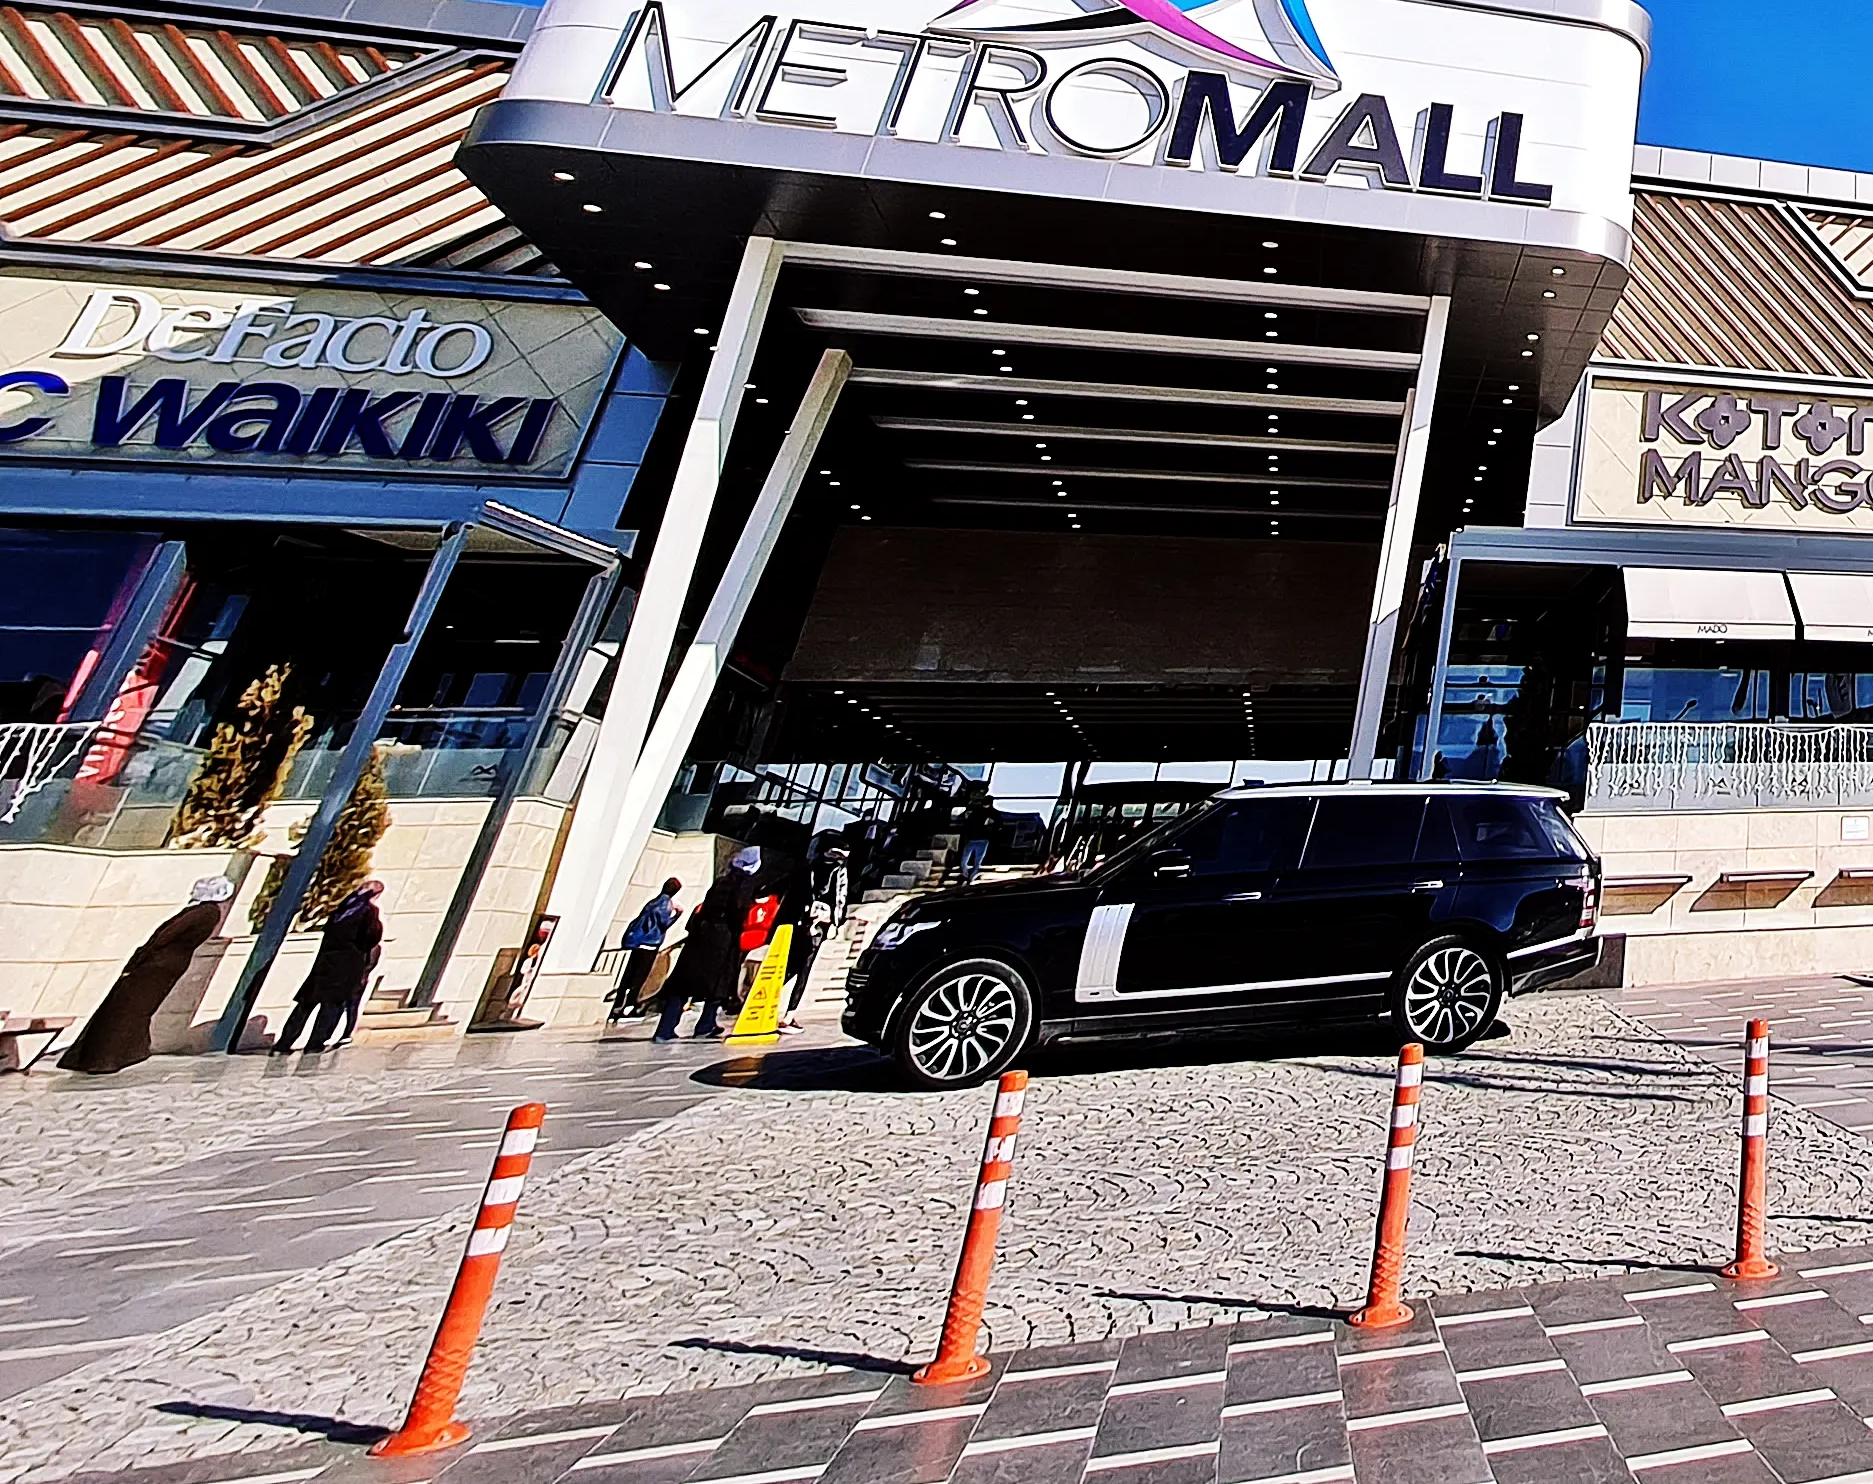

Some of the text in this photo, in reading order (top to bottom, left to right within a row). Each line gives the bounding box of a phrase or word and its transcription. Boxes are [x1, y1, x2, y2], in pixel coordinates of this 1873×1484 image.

[602, 0, 1554, 206] METROMALL
[50, 288, 493, 379] DeFacto
[1696, 624, 1729, 635] MADO
